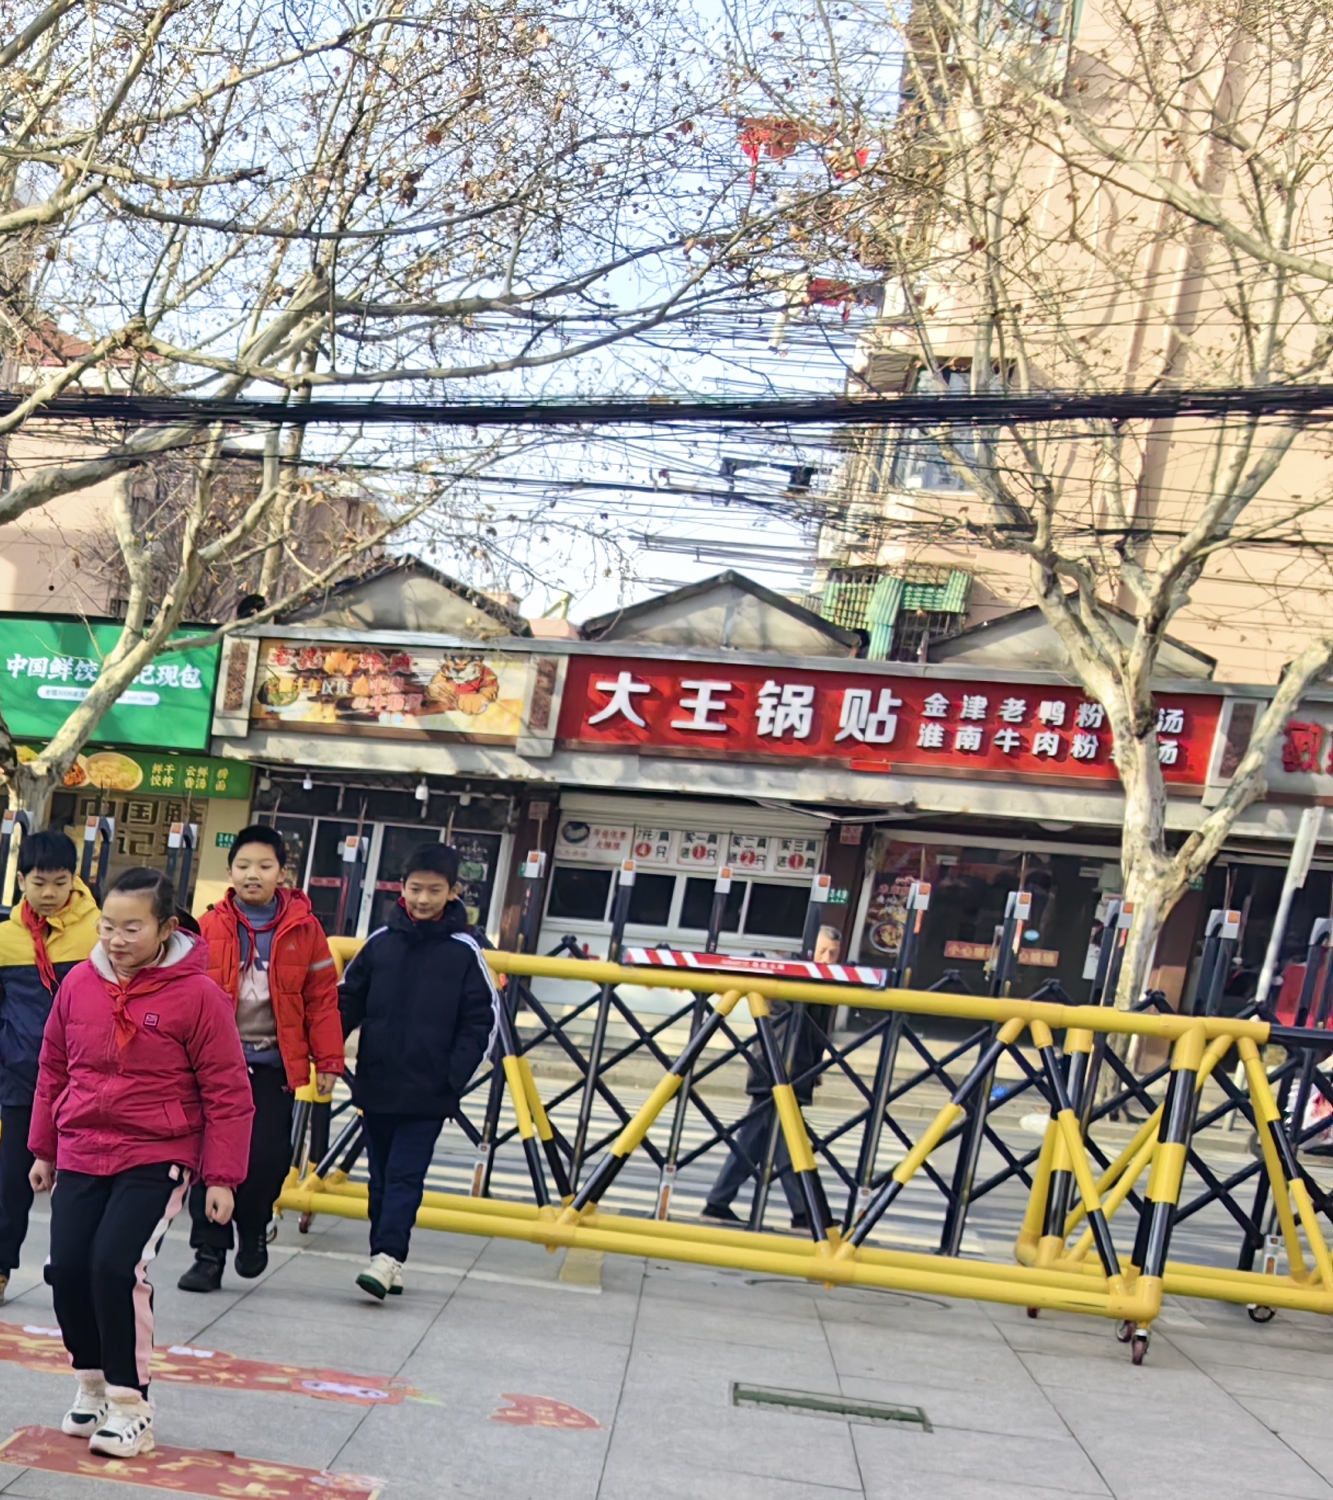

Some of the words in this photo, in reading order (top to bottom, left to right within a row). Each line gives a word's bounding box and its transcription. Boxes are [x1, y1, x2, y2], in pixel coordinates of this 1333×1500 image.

[6, 653, 99, 682] 中国鲜饺
[588, 671, 903, 743] 大王锅贴
[922, 692, 1185, 734] 金津老鸭粉汤
[916, 723, 1179, 765] 淮南牛肉粉汤
